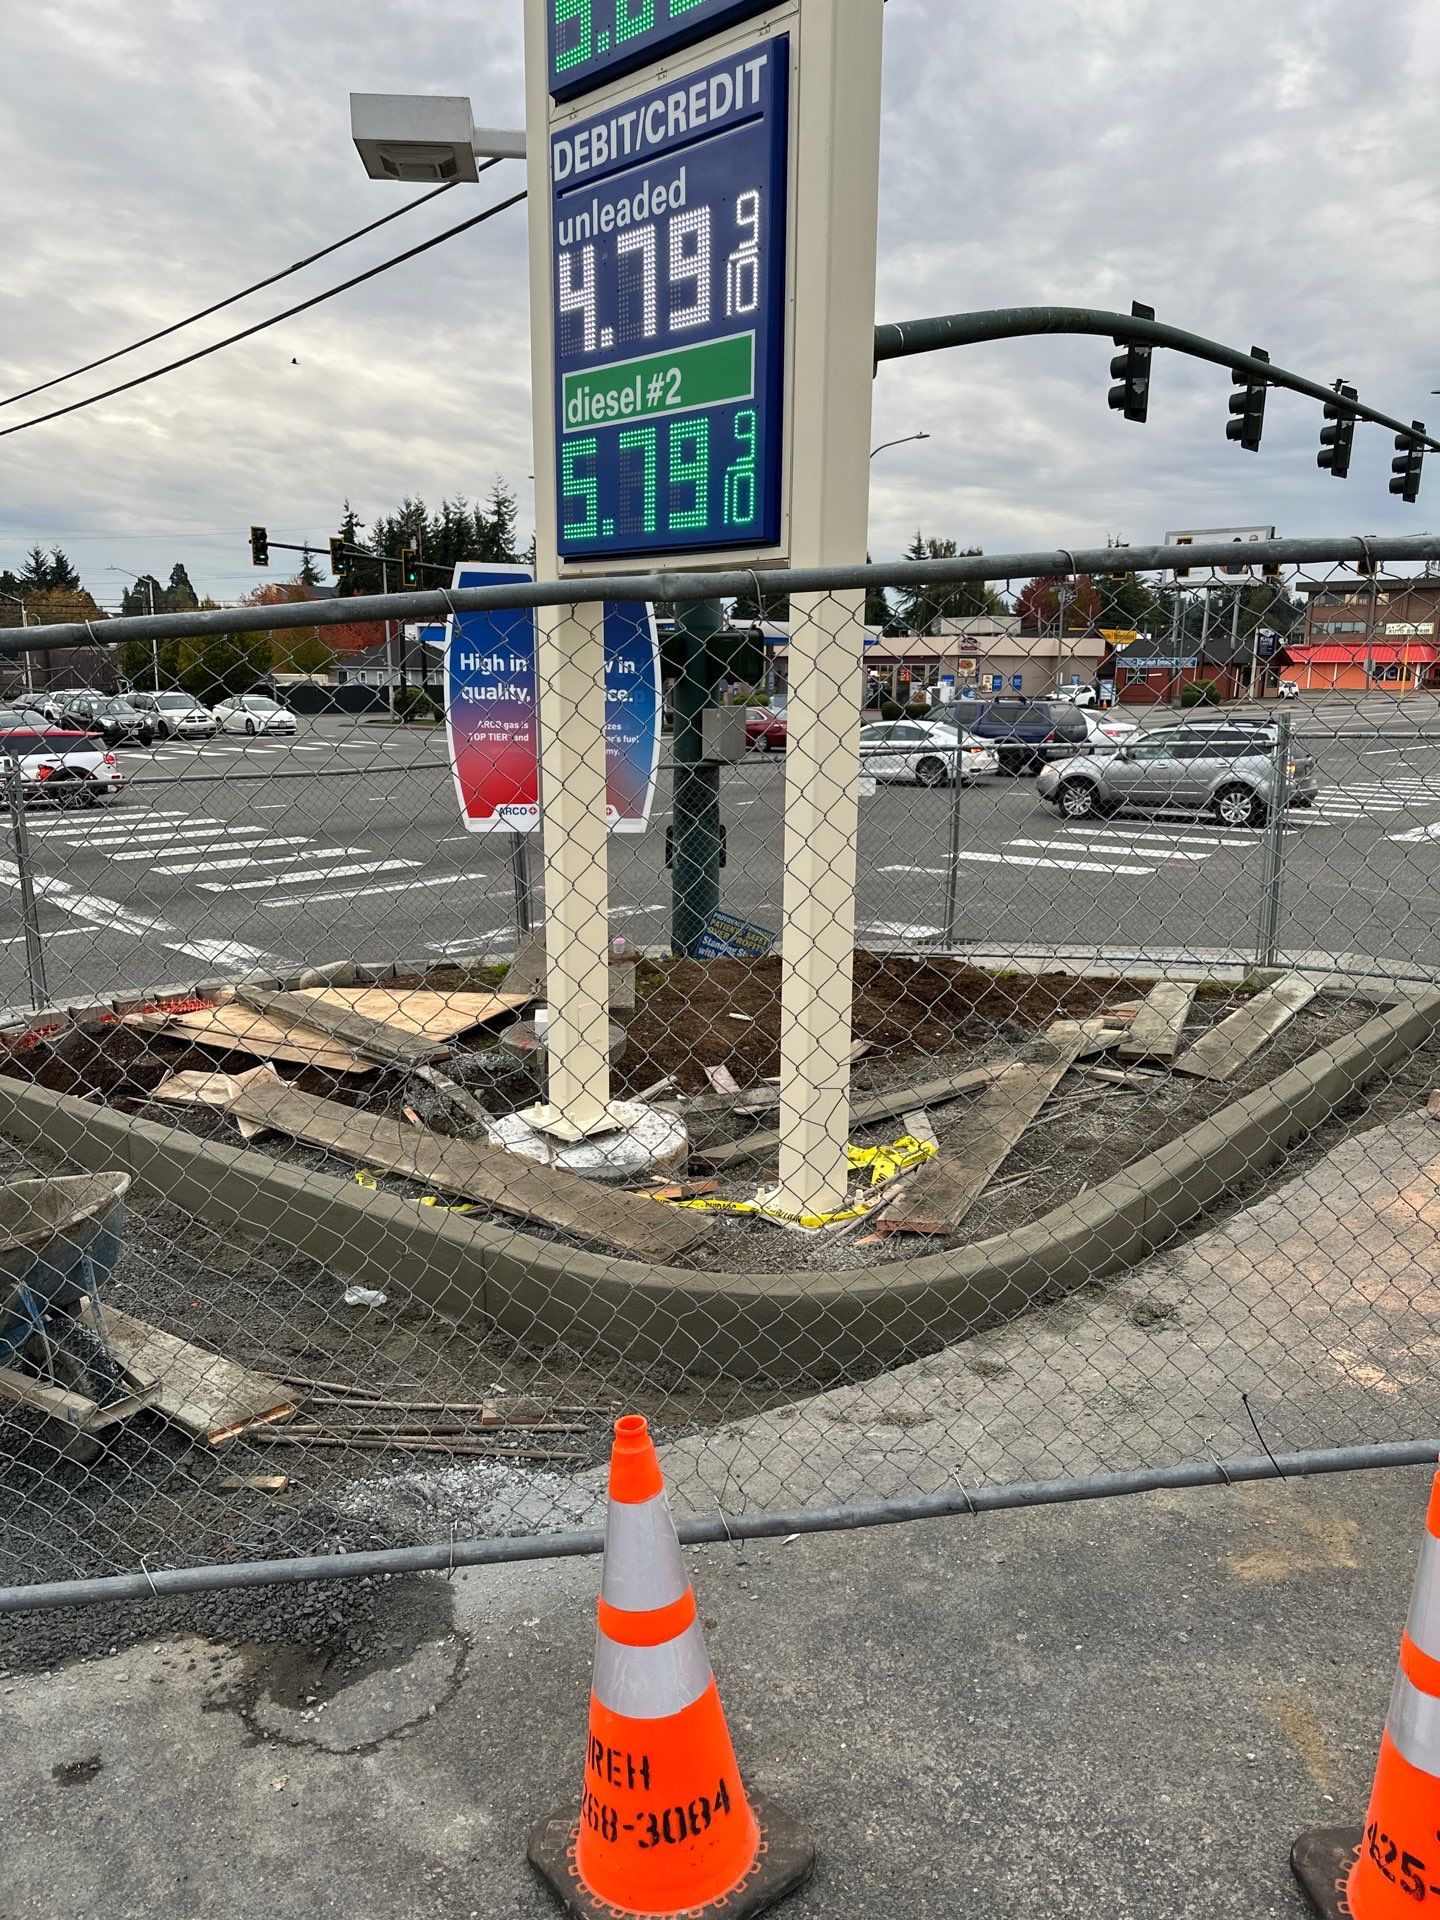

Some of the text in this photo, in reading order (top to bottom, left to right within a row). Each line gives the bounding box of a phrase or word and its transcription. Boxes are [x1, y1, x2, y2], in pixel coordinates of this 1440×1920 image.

[553, 54, 768, 182] DEBIT/CREDIT
[558, 165, 687, 246] unleaded
[559, 205, 711, 352] 4.79
[567, 367, 682, 424] diesel #2
[562, 417, 709, 540] 5.79
[460, 653, 528, 676] High in
[618, 657, 635, 674] in
[461, 684, 531, 704] quality,
[478, 720, 502, 729] ARCO
[504, 722, 519, 731] gas
[468, 733, 487, 741] TOP
[513, 733, 529, 742] and
[499, 806, 528, 816] ARCO
